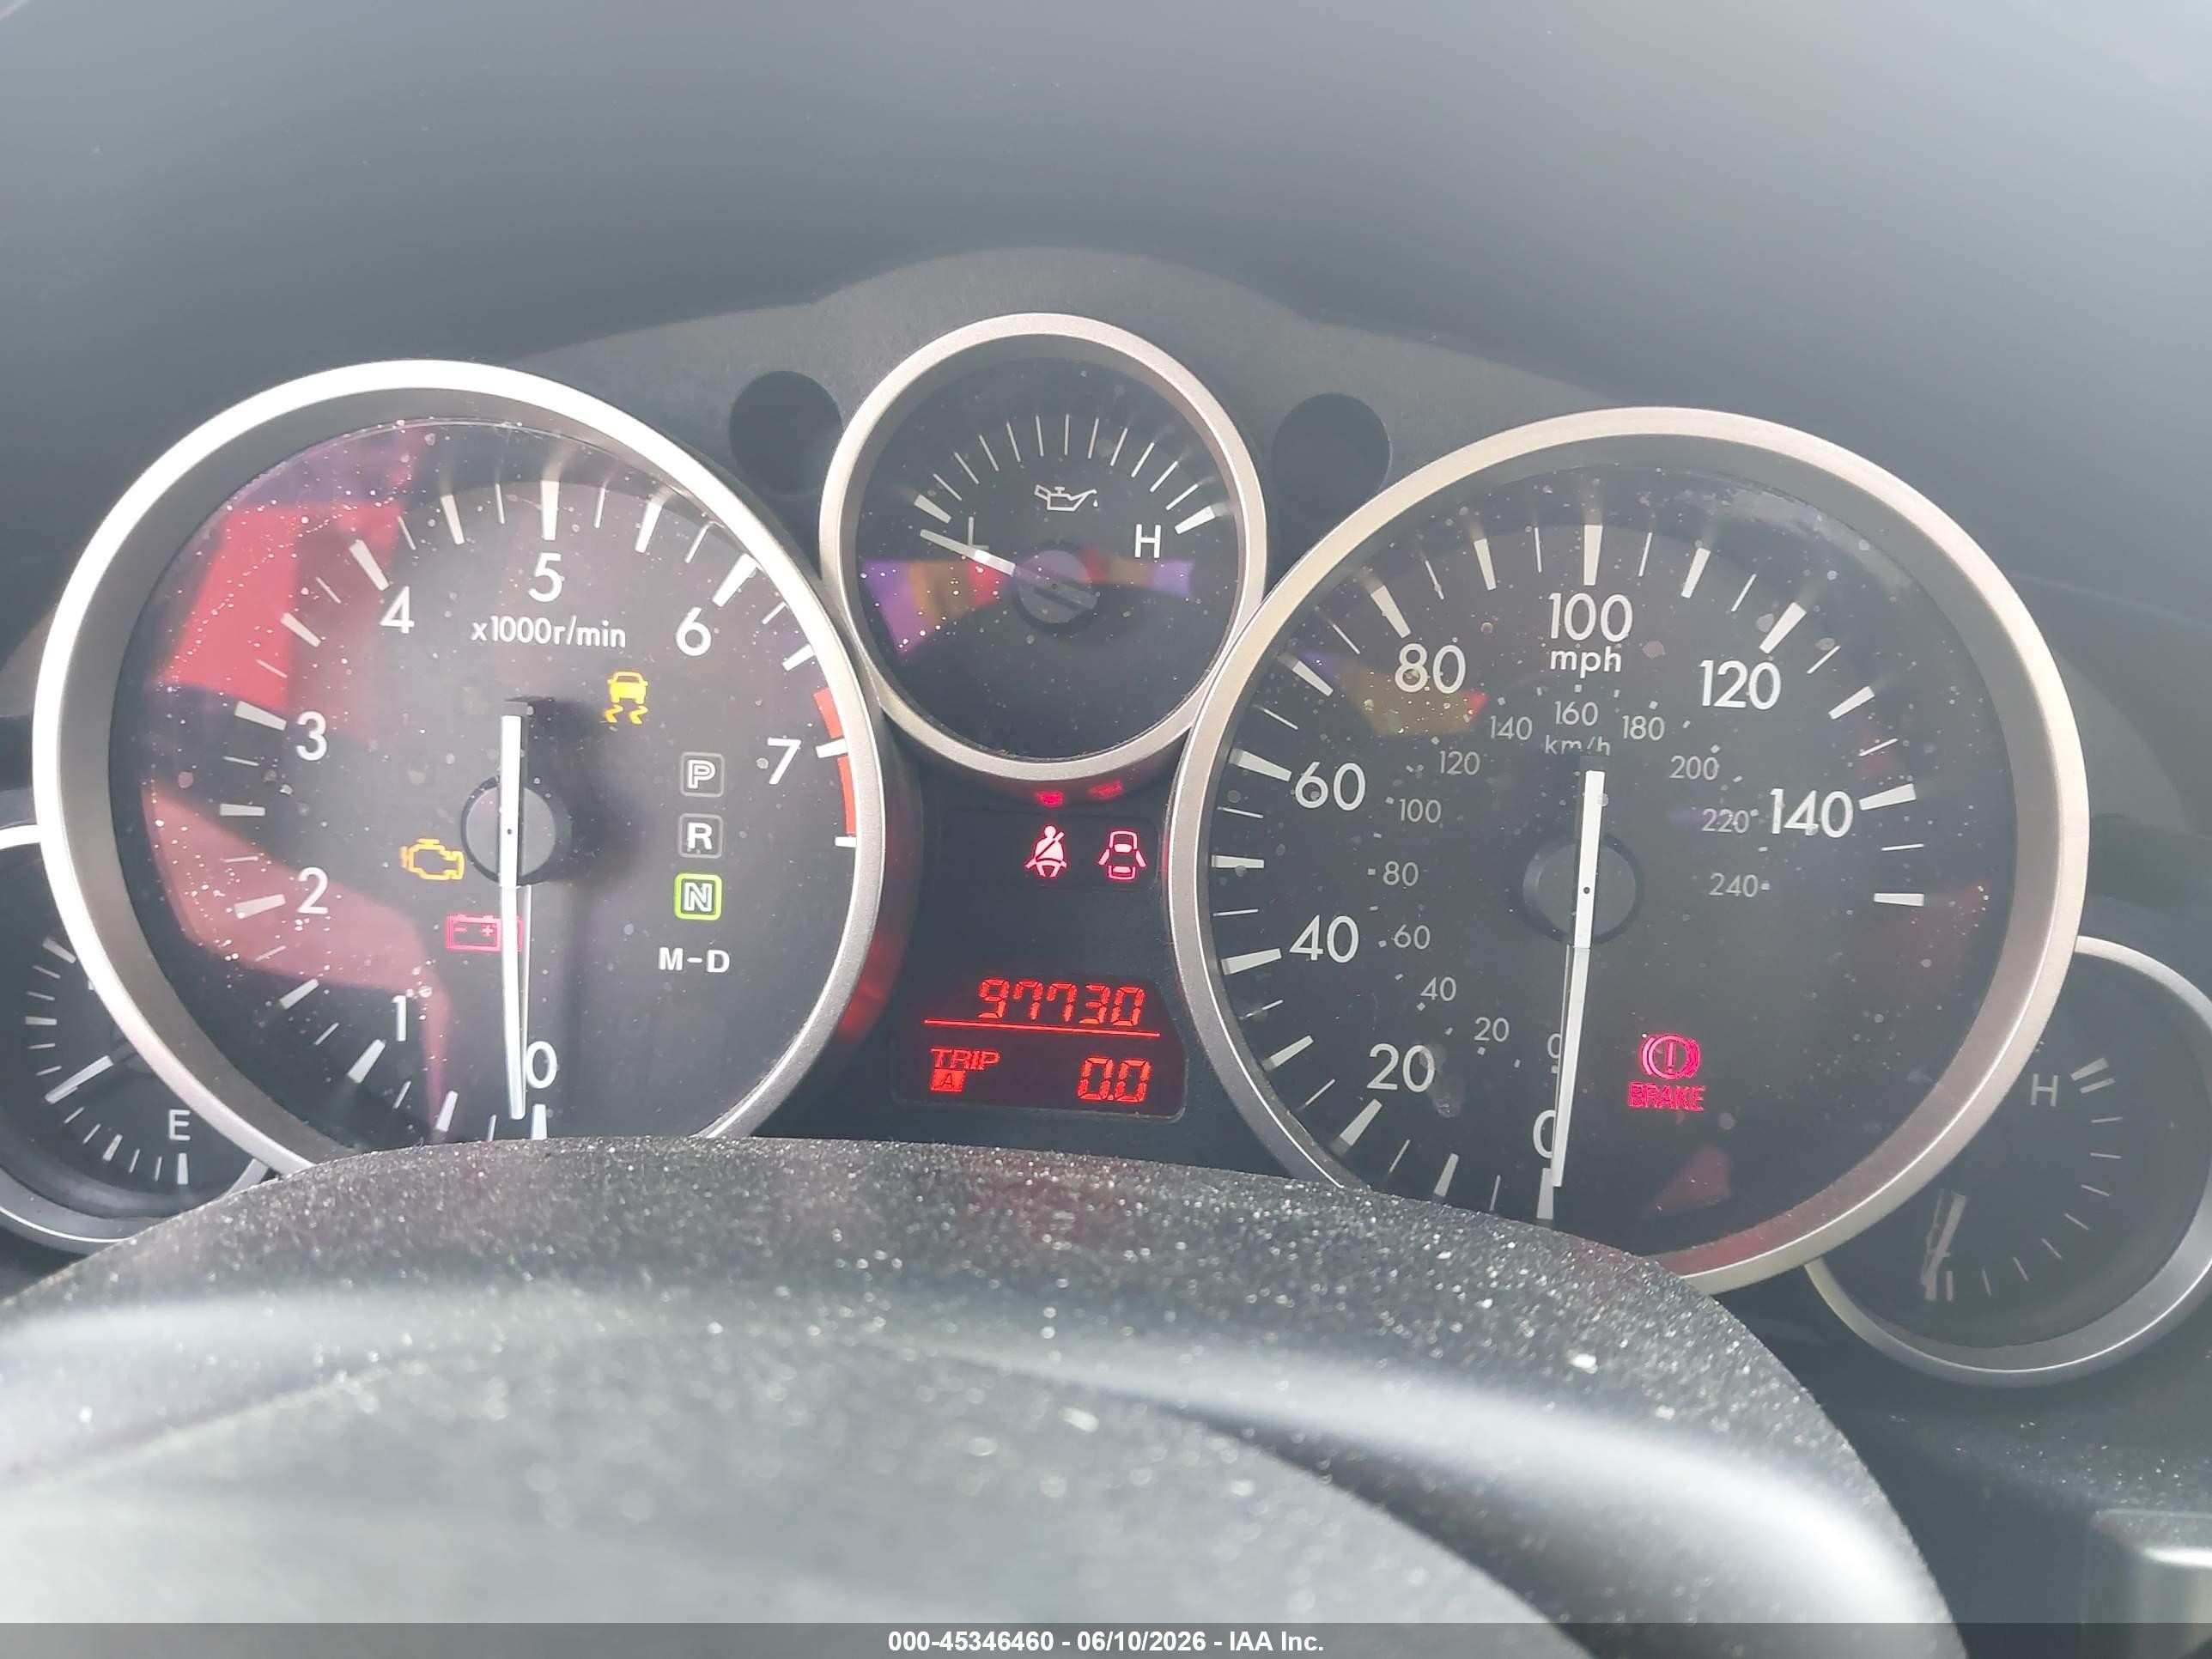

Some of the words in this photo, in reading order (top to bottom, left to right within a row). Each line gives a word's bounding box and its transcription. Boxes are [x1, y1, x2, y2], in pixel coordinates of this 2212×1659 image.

[1135, 523, 1161, 558] H
[528, 552, 562, 603] 5
[380, 586, 414, 633] 4
[1547, 592, 1633, 641] 100
[471, 615, 627, 647] x1000r/min
[676, 606, 712, 656] 6
[1395, 643, 1467, 694] 80
[1550, 647, 1622, 678] mph
[1699, 660, 1781, 710] 120
[1491, 715, 1533, 740] 140
[1554, 701, 1598, 726] 160
[1622, 716, 1665, 741] 180
[296, 711, 327, 761] 3
[1545, 736, 1611, 757] km/h
[687, 760, 716, 788] P
[767, 738, 801, 785] 7
[1439, 750, 1480, 776] 120
[1669, 756, 1719, 781] 200
[1295, 762, 1366, 811] 60
[1399, 799, 1442, 823] 100
[1701, 809, 1749, 834] 220
[1771, 788, 1853, 838] 140
[687, 823, 713, 850] R
[1382, 861, 1419, 887] 80
[1709, 873, 1759, 898] 240
[298, 866, 328, 914] 2
[684, 883, 712, 910] N
[1288, 915, 1359, 963] 40
[1394, 925, 1431, 950] 60
[979, 979, 1145, 1026] 97730
[1420, 977, 1457, 1002] 40
[392, 995, 406, 1042] 1
[1474, 1017, 1510, 1042] 20
[526, 1040, 558, 1089] 0
[930, 1048, 1001, 1071] TRIP
[1366, 1043, 1436, 1092] 20
[1628, 1082, 1705, 1112] BRAKE
[2031, 1073, 2059, 1107] H
[168, 1109, 191, 1140] E
